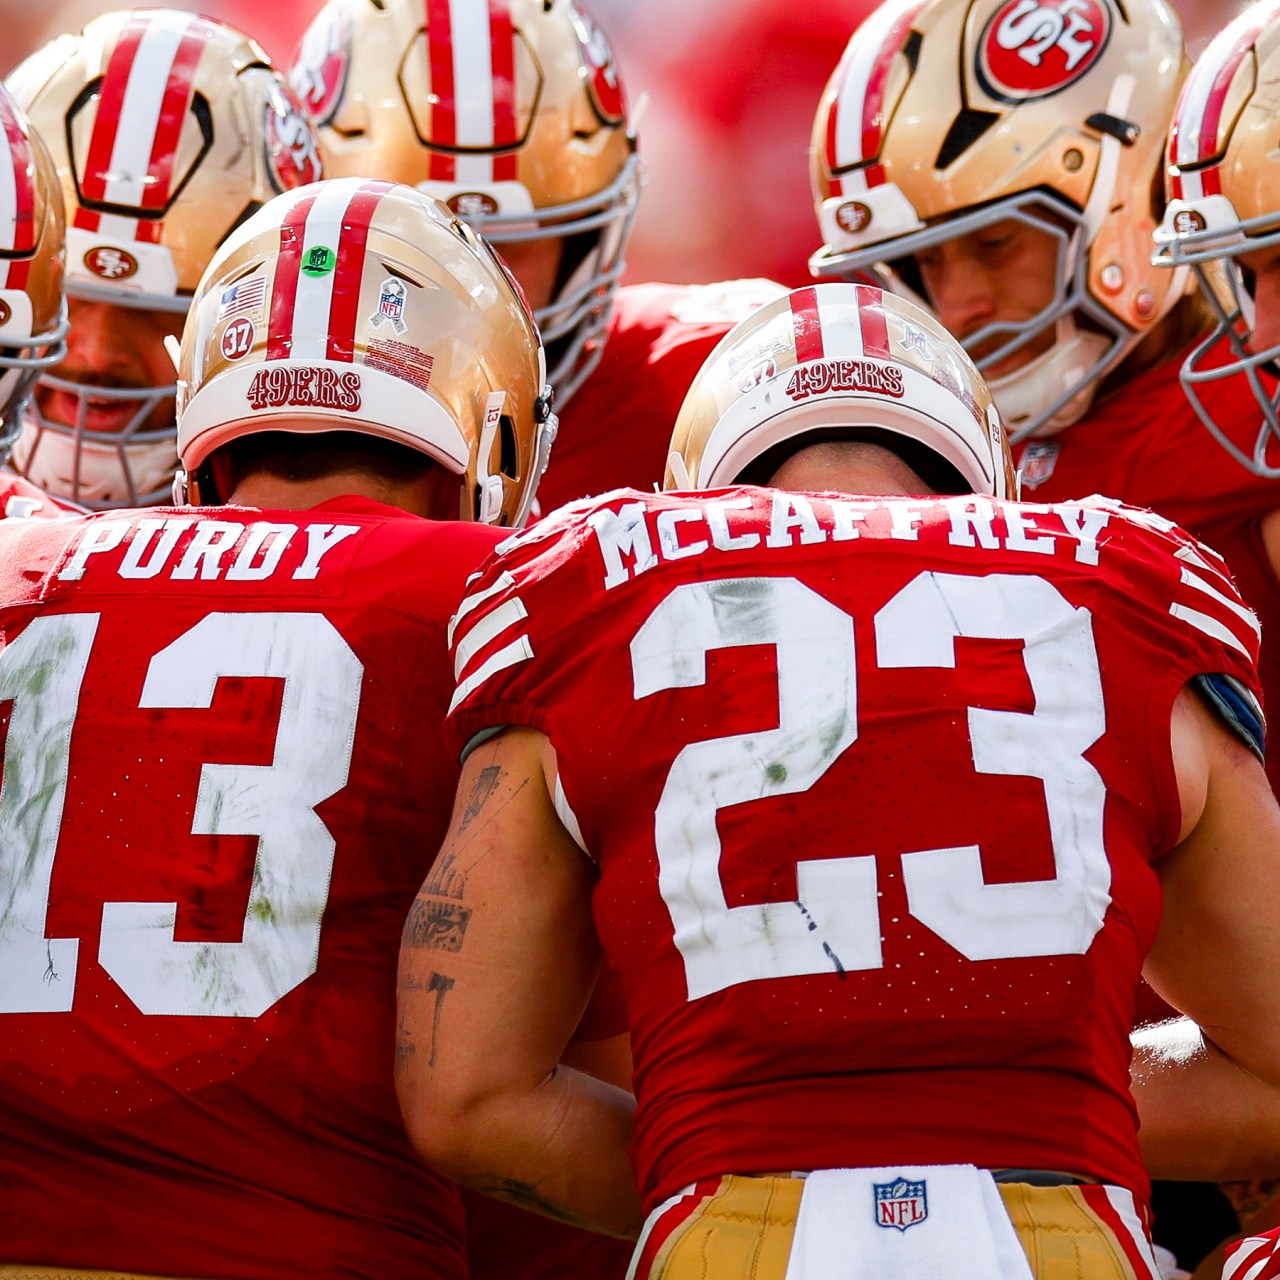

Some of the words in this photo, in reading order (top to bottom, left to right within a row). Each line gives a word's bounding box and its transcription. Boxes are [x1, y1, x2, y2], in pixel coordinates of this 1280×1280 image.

[97, 250, 130, 278] SF
[382, 302, 400, 317] NFL
[223, 322, 252, 355] 37
[247, 367, 362, 413] 49ERS
[785, 360, 905, 401] 49ERS
[487, 406, 501, 424] 13
[57, 519, 362, 581] PURDY
[629, 570, 1113, 1003] 23
[880, 1200, 924, 1226] NFL
